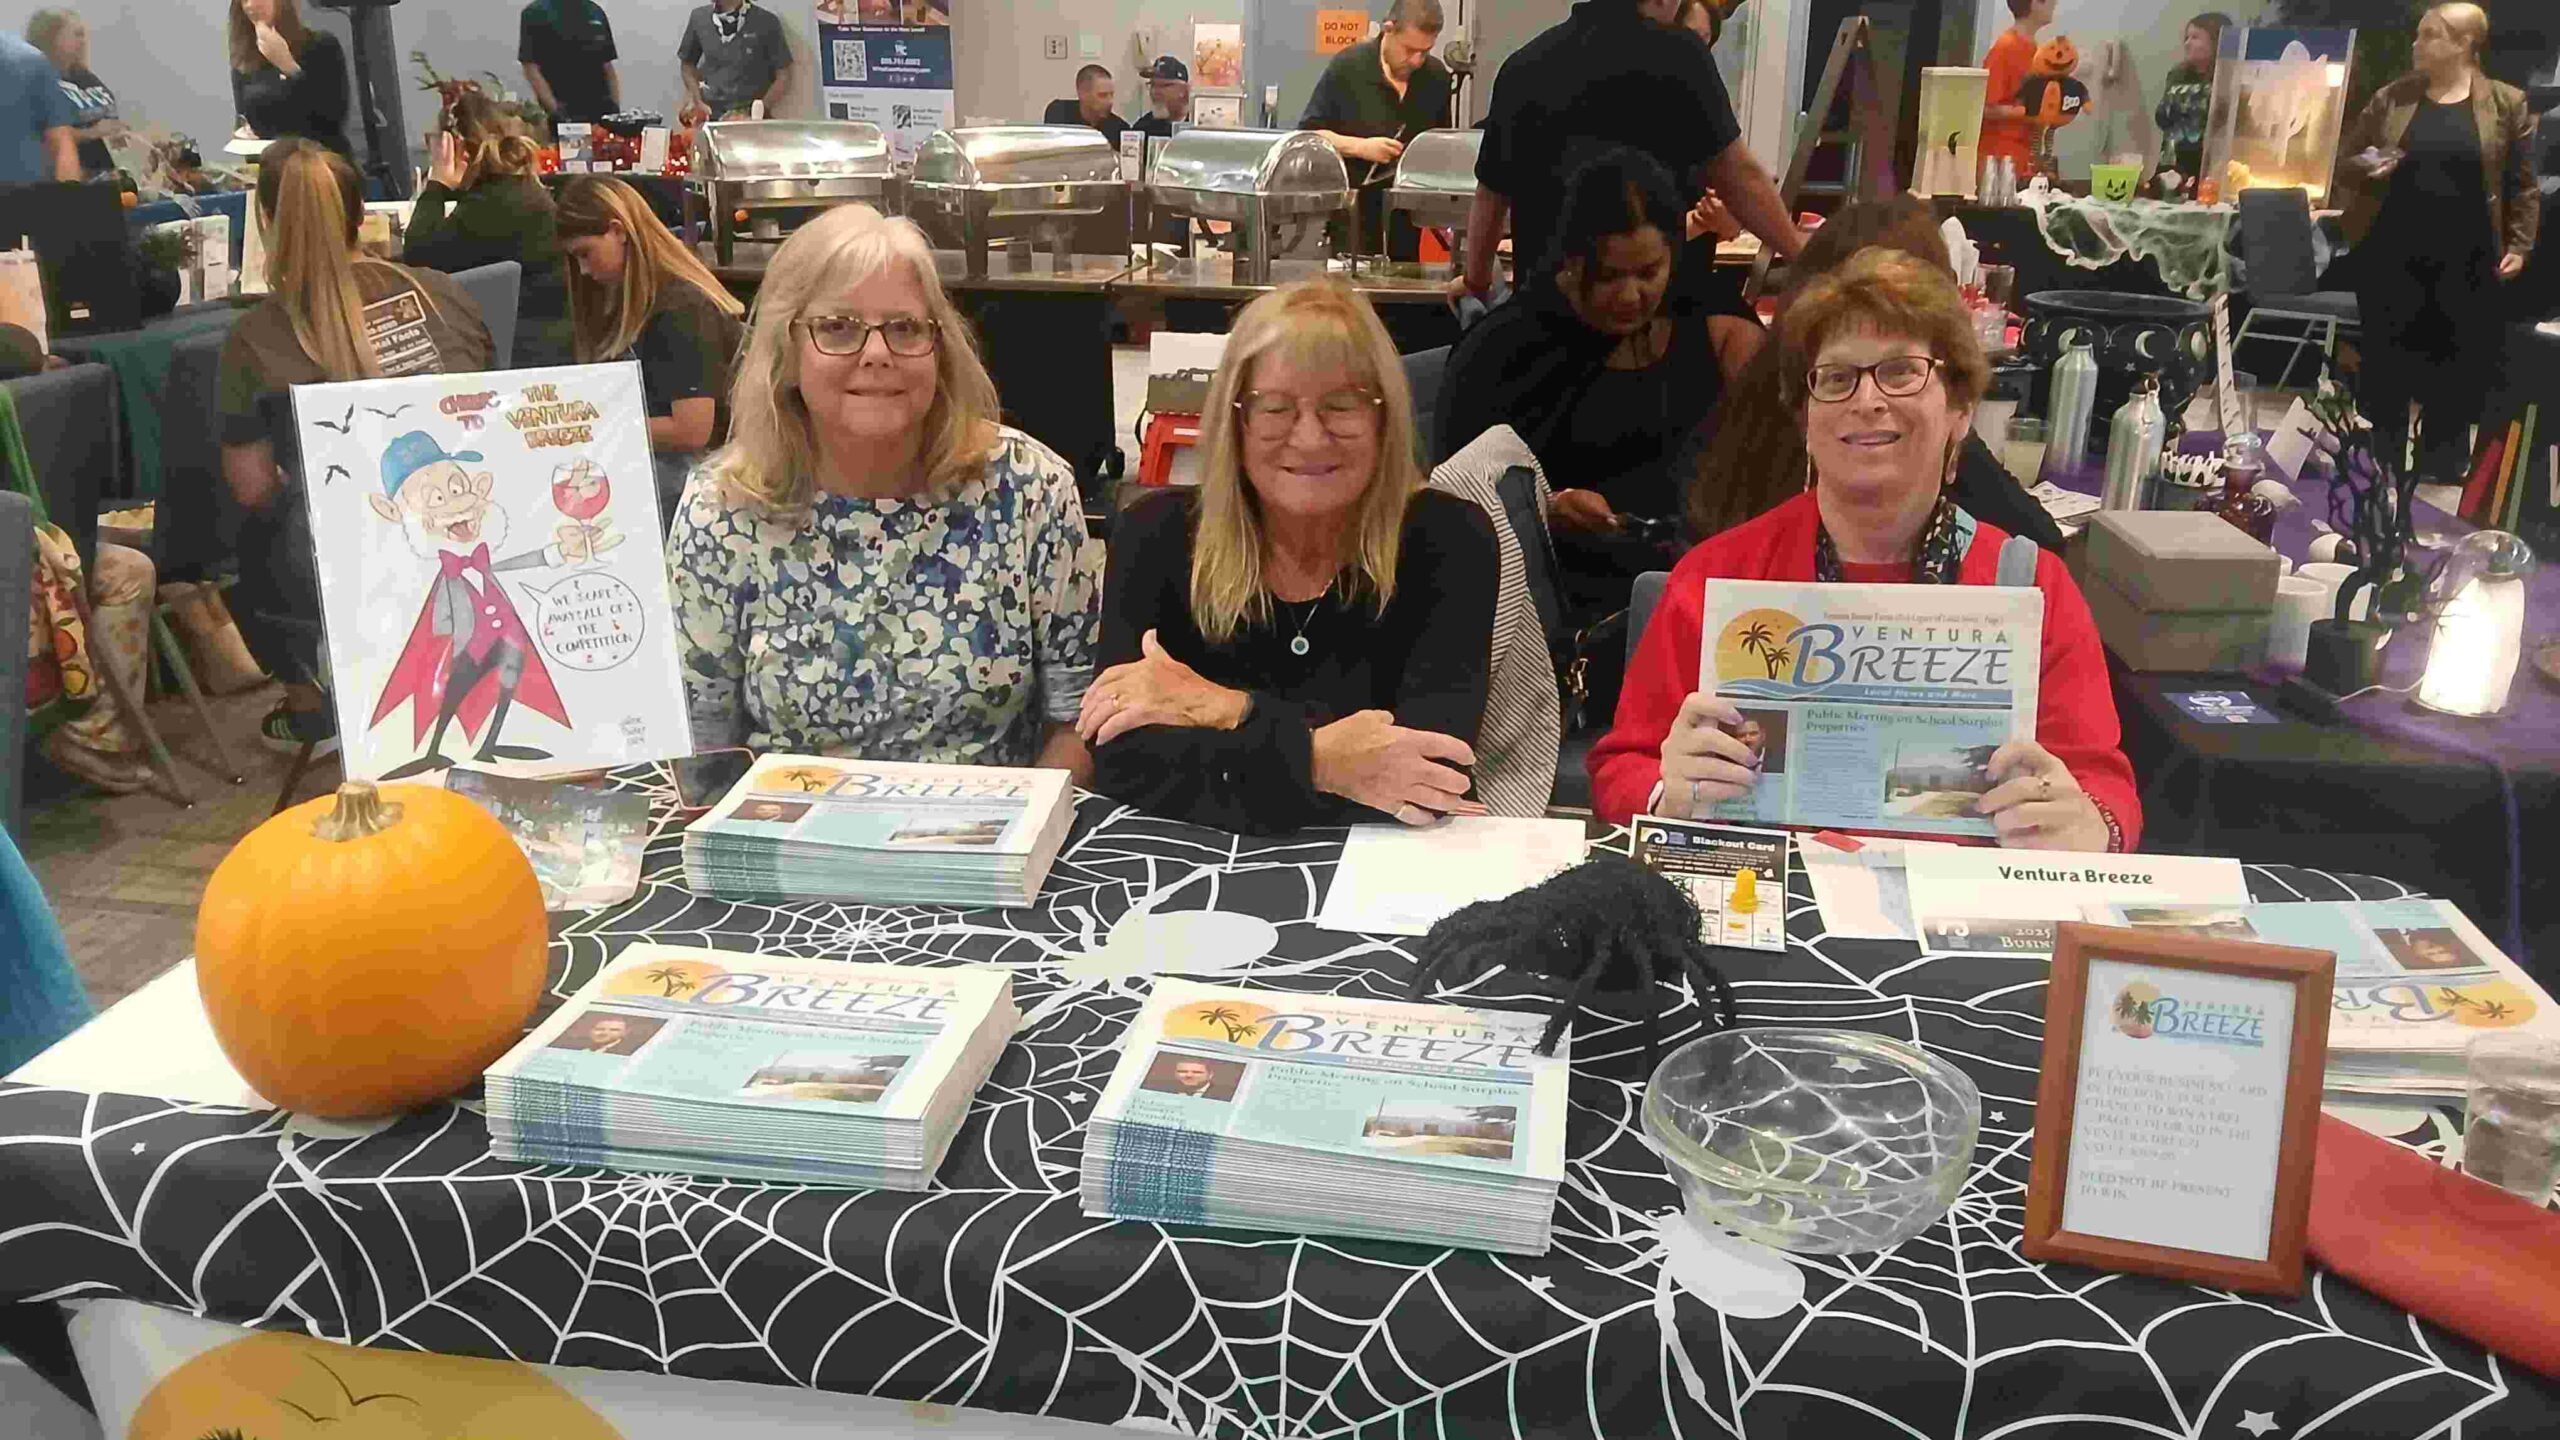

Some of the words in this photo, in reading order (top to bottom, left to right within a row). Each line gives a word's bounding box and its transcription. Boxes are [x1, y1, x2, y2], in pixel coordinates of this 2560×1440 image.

[1324, 22, 1338, 31] DO
[1340, 22, 1359, 31] NOT
[1325, 36, 1357, 45] BLOCK
[522, 384, 559, 403] THE
[505, 400, 600, 430] VENTURA
[524, 425, 593, 448] BREEZE
[577, 623, 598, 635] THE
[1853, 626, 2008, 643] VENTURA
[556, 634, 633, 654] COMPETITION
[1786, 623, 2013, 687] BREEZE
[1865, 687, 1892, 697] Local
[1894, 688, 1924, 698] News
[1927, 689, 1947, 699] and
[1951, 690, 1977, 700] More
[1806, 721, 1865, 734] Properties
[1807, 708, 1845, 720] Public
[1847, 710, 1894, 725] Meeting
[1897, 716, 1913, 724] on
[1916, 713, 1956, 726] School
[1958, 714, 2005, 729] Surplus
[827, 773, 1029, 799] BREEZE
[1693, 836, 1746, 849] Blackout
[1747, 841, 1776, 852] Card
[1999, 865, 2081, 883] Ventura
[2084, 869, 2154, 885] Breeze
[2015, 928, 2052, 938] 2025
[689, 972, 959, 1020] BREEZE
[781, 975, 957, 998] VENTURA
[2150, 997, 2265, 1039] BREEZE
[1336, 1017, 1527, 1044] VENTURA
[1254, 1014, 1534, 1069] BREEZE
[1267, 1072, 1342, 1088] Properties
[1270, 1064, 1315, 1077] Public
[1323, 1068, 1381, 1085] Meeting
[1384, 1078, 1404, 1086] on
[1408, 1079, 1458, 1092] School
[1460, 1084, 1520, 1096] Surplus
[2079, 1170, 2118, 1185] NEED
[2119, 1174, 2147, 1189] NOT
[2171, 1179, 2233, 1199] PRESENT
